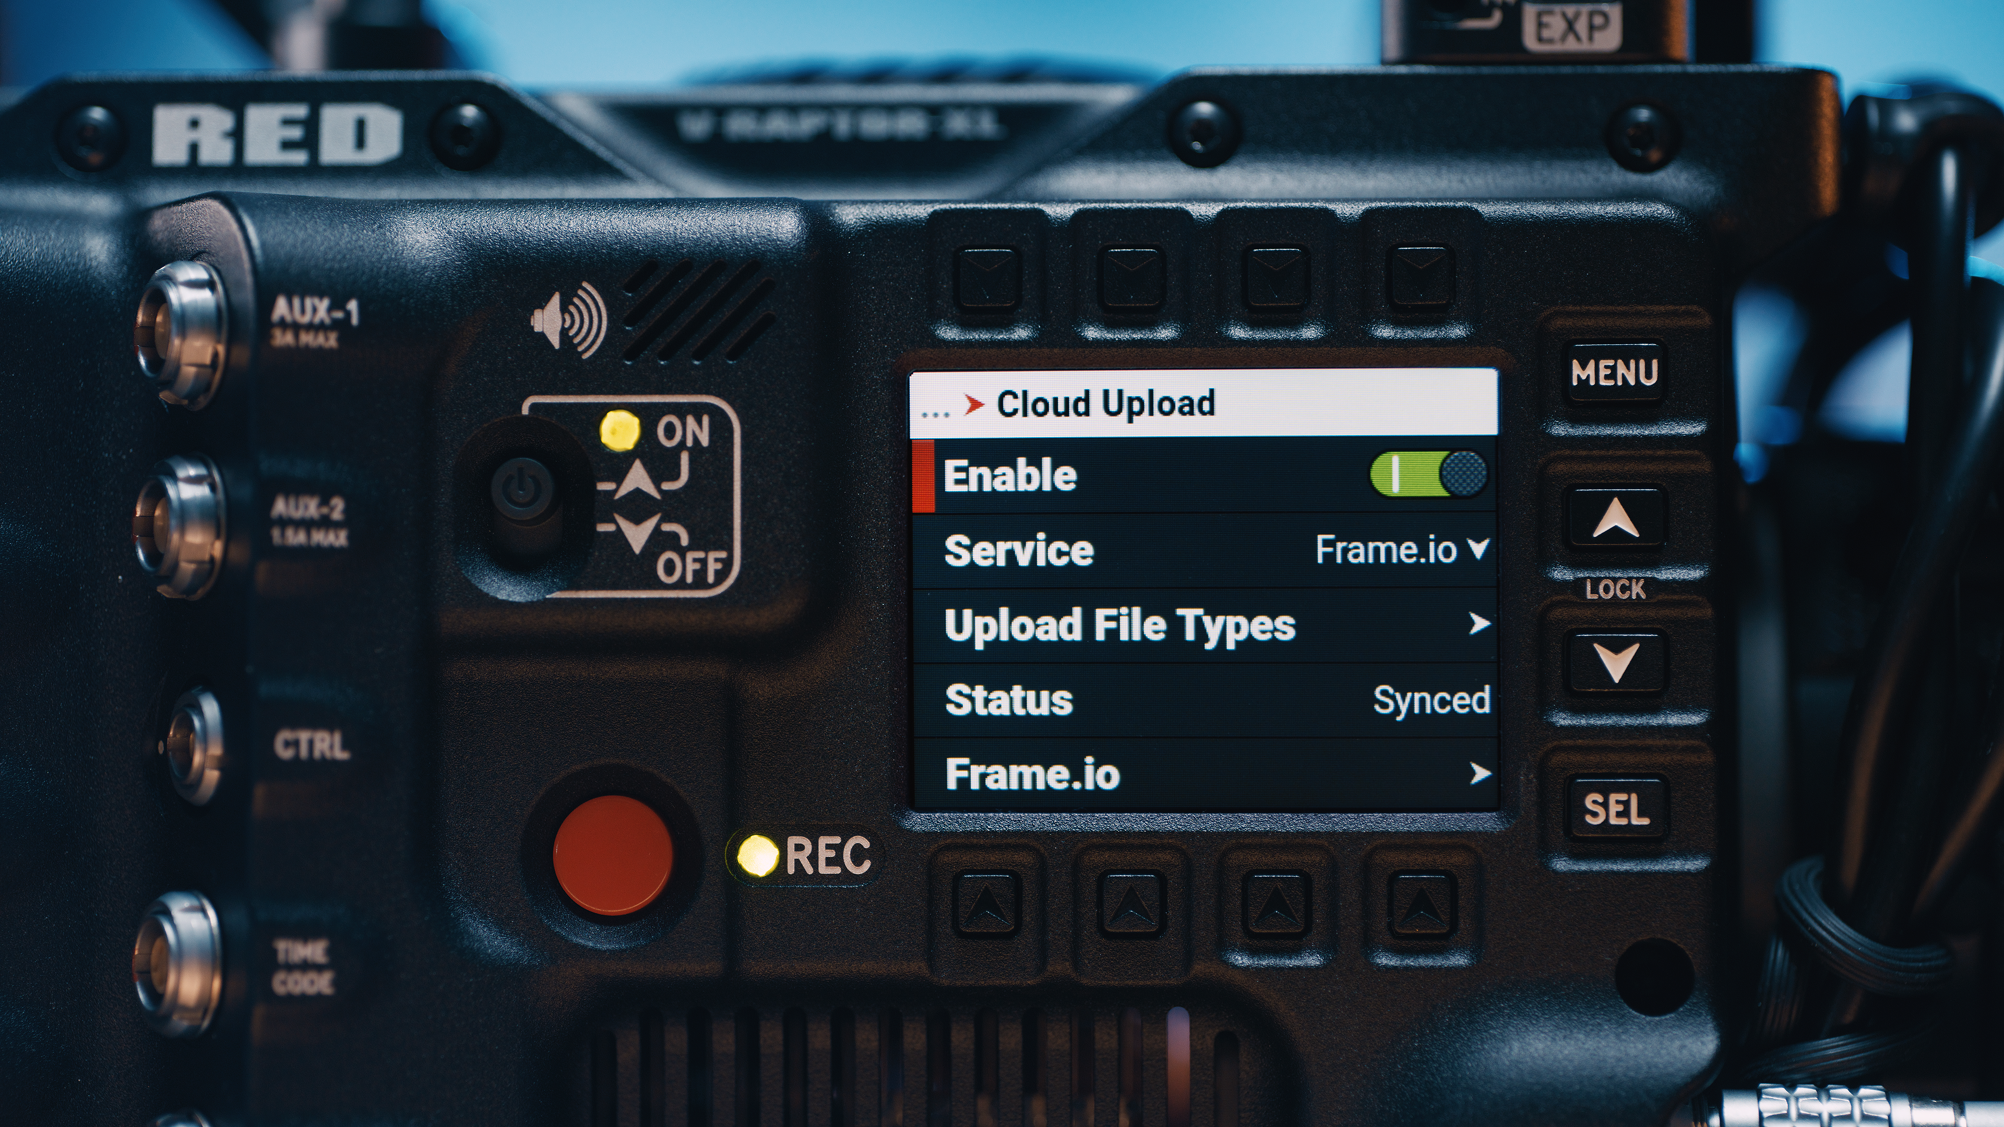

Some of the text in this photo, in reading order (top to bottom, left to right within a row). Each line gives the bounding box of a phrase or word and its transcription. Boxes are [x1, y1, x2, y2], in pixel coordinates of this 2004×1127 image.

[1535, 9, 1611, 45] EXP
[152, 103, 403, 167] RED
[271, 294, 359, 326] AUX-1
[298, 329, 339, 349] MAX
[1571, 358, 1659, 387] MENU
[997, 388, 1215, 424] Cloud Upload
[656, 413, 710, 448] ON
[944, 456, 1078, 493] Enable
[270, 494, 346, 521] AUX-2
[309, 527, 349, 548] MAX
[944, 531, 1095, 567] Service
[1316, 533, 1458, 564] Frame.io
[656, 550, 728, 585] OFF
[1586, 578, 1647, 600] LOCK
[945, 606, 1297, 651] Upload File Types
[945, 682, 1074, 716] Status
[1373, 684, 1491, 722] Synced
[273, 729, 351, 760] CTRL
[946, 755, 1121, 791] Frame.io
[1584, 792, 1651, 826] SEL
[786, 835, 872, 875] REC
[273, 938, 329, 964] TIME
[271, 970, 335, 996] CODE
